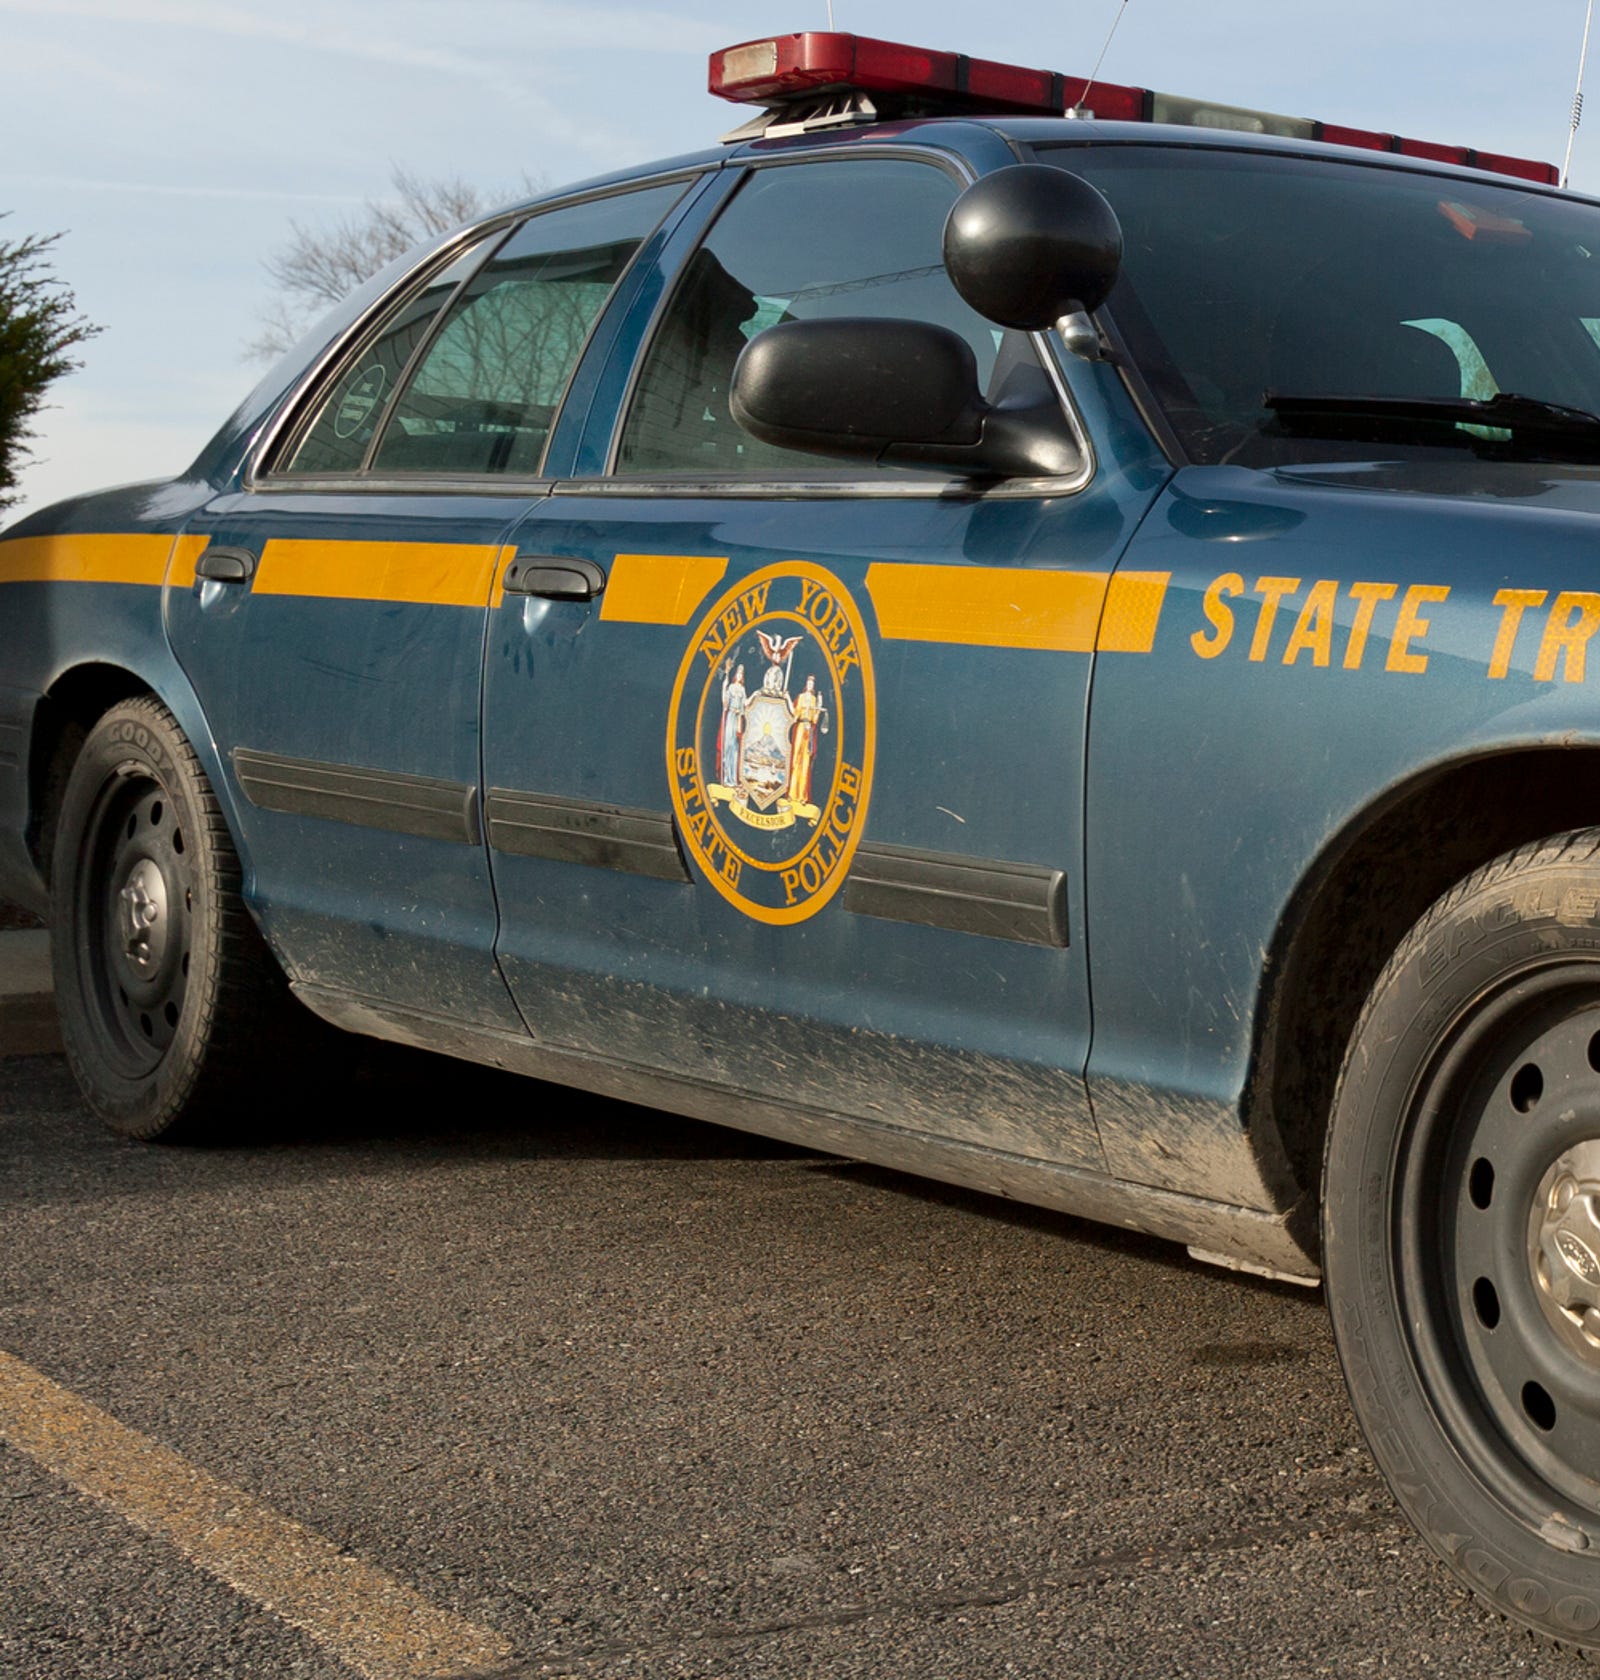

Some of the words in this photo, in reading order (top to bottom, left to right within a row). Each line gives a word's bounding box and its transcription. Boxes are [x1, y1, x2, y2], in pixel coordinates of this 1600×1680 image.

[699, 580, 772, 668] NEW
[795, 578, 860, 684] YORK
[1190, 572, 1450, 673] STATE
[676, 747, 742, 888] STATE
[780, 763, 862, 905] POLICE
